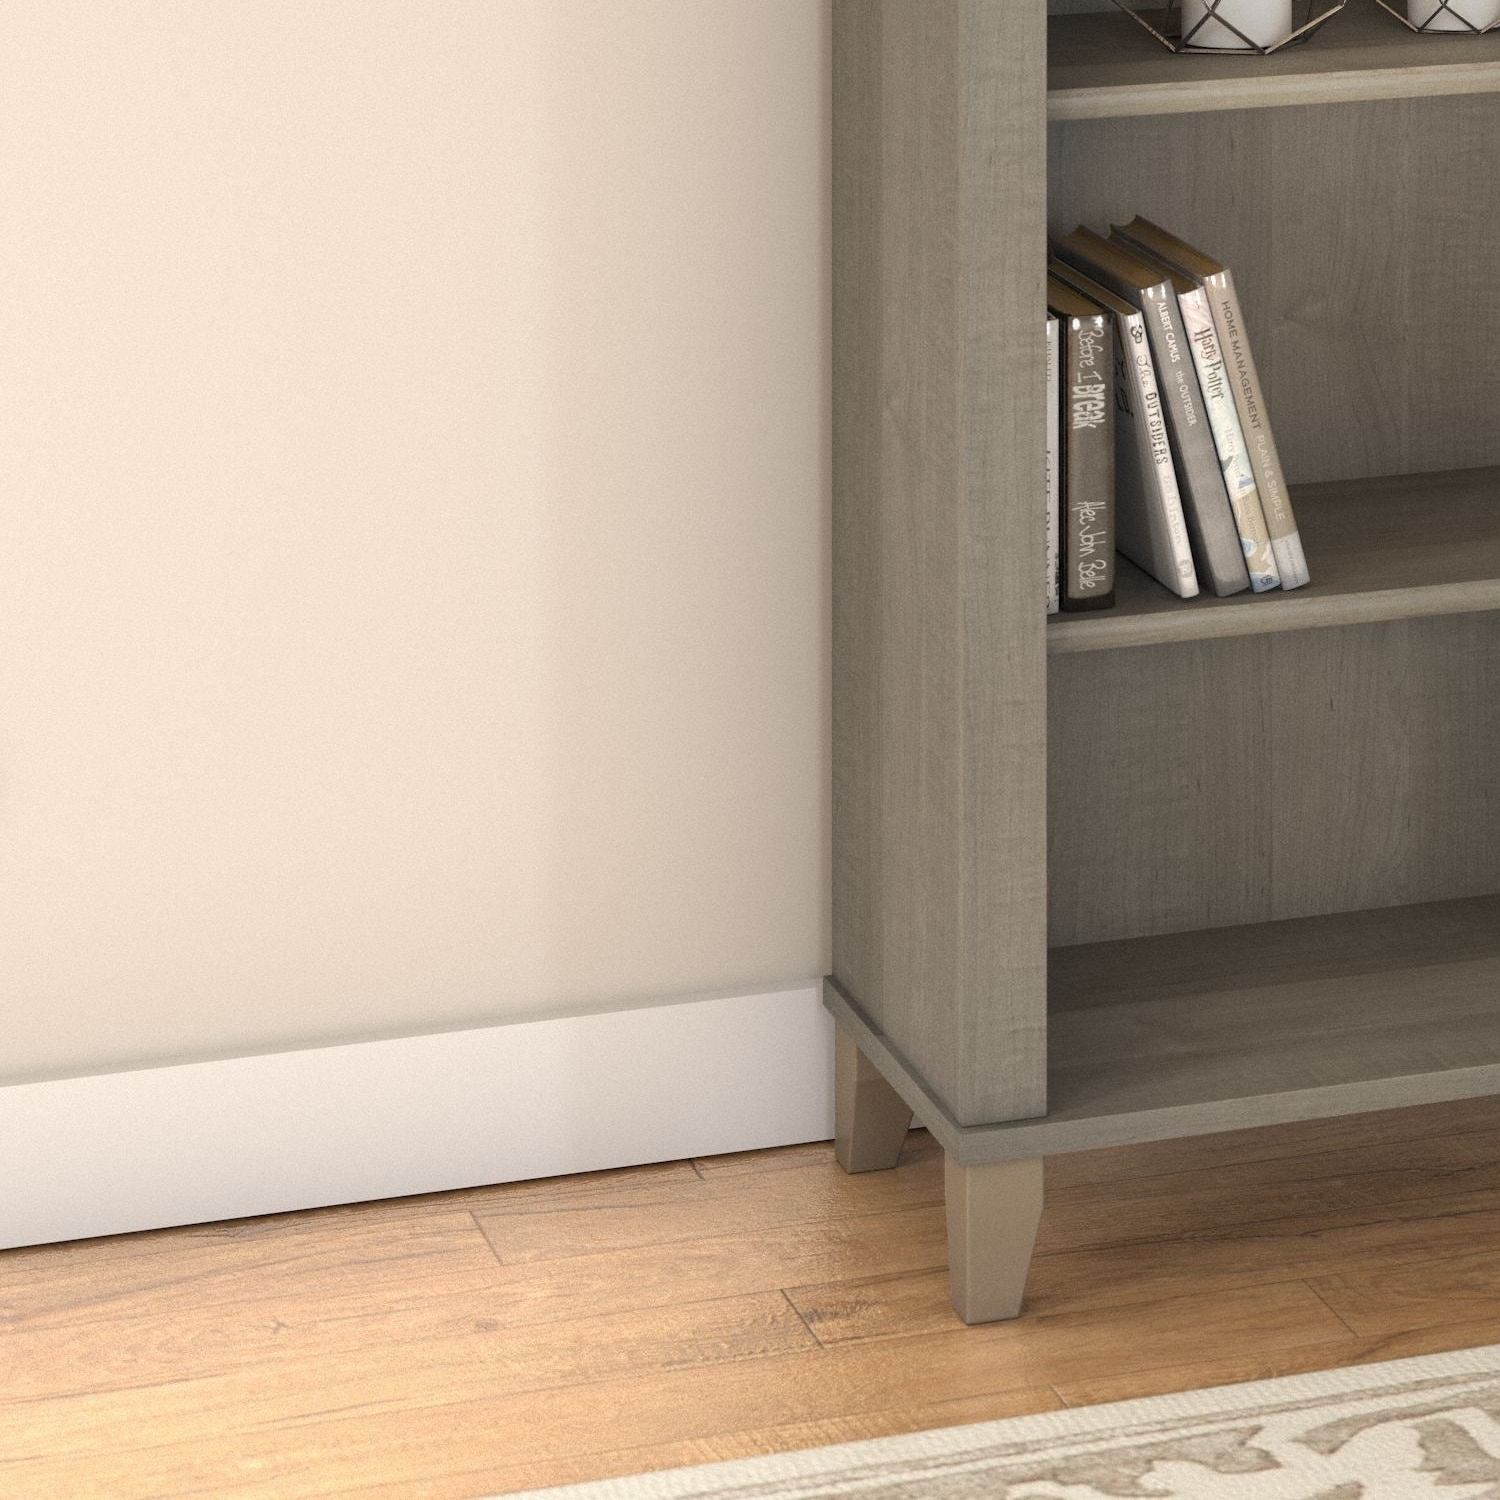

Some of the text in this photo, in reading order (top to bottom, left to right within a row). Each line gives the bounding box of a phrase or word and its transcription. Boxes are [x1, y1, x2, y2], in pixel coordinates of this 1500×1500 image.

[1136, 354, 1152, 388] The
[1145, 392, 1169, 465] OUTSIDERS
[1156, 301, 1197, 426] ALBERT CAMUS the OUTSIDER
[1194, 327, 1226, 400] Harry Potter
[1221, 300, 1284, 520] HOME MANAGEMENT PLAIN & SIMPLE
[1072, 330, 1107, 590] Before I Break Alec John Belle
